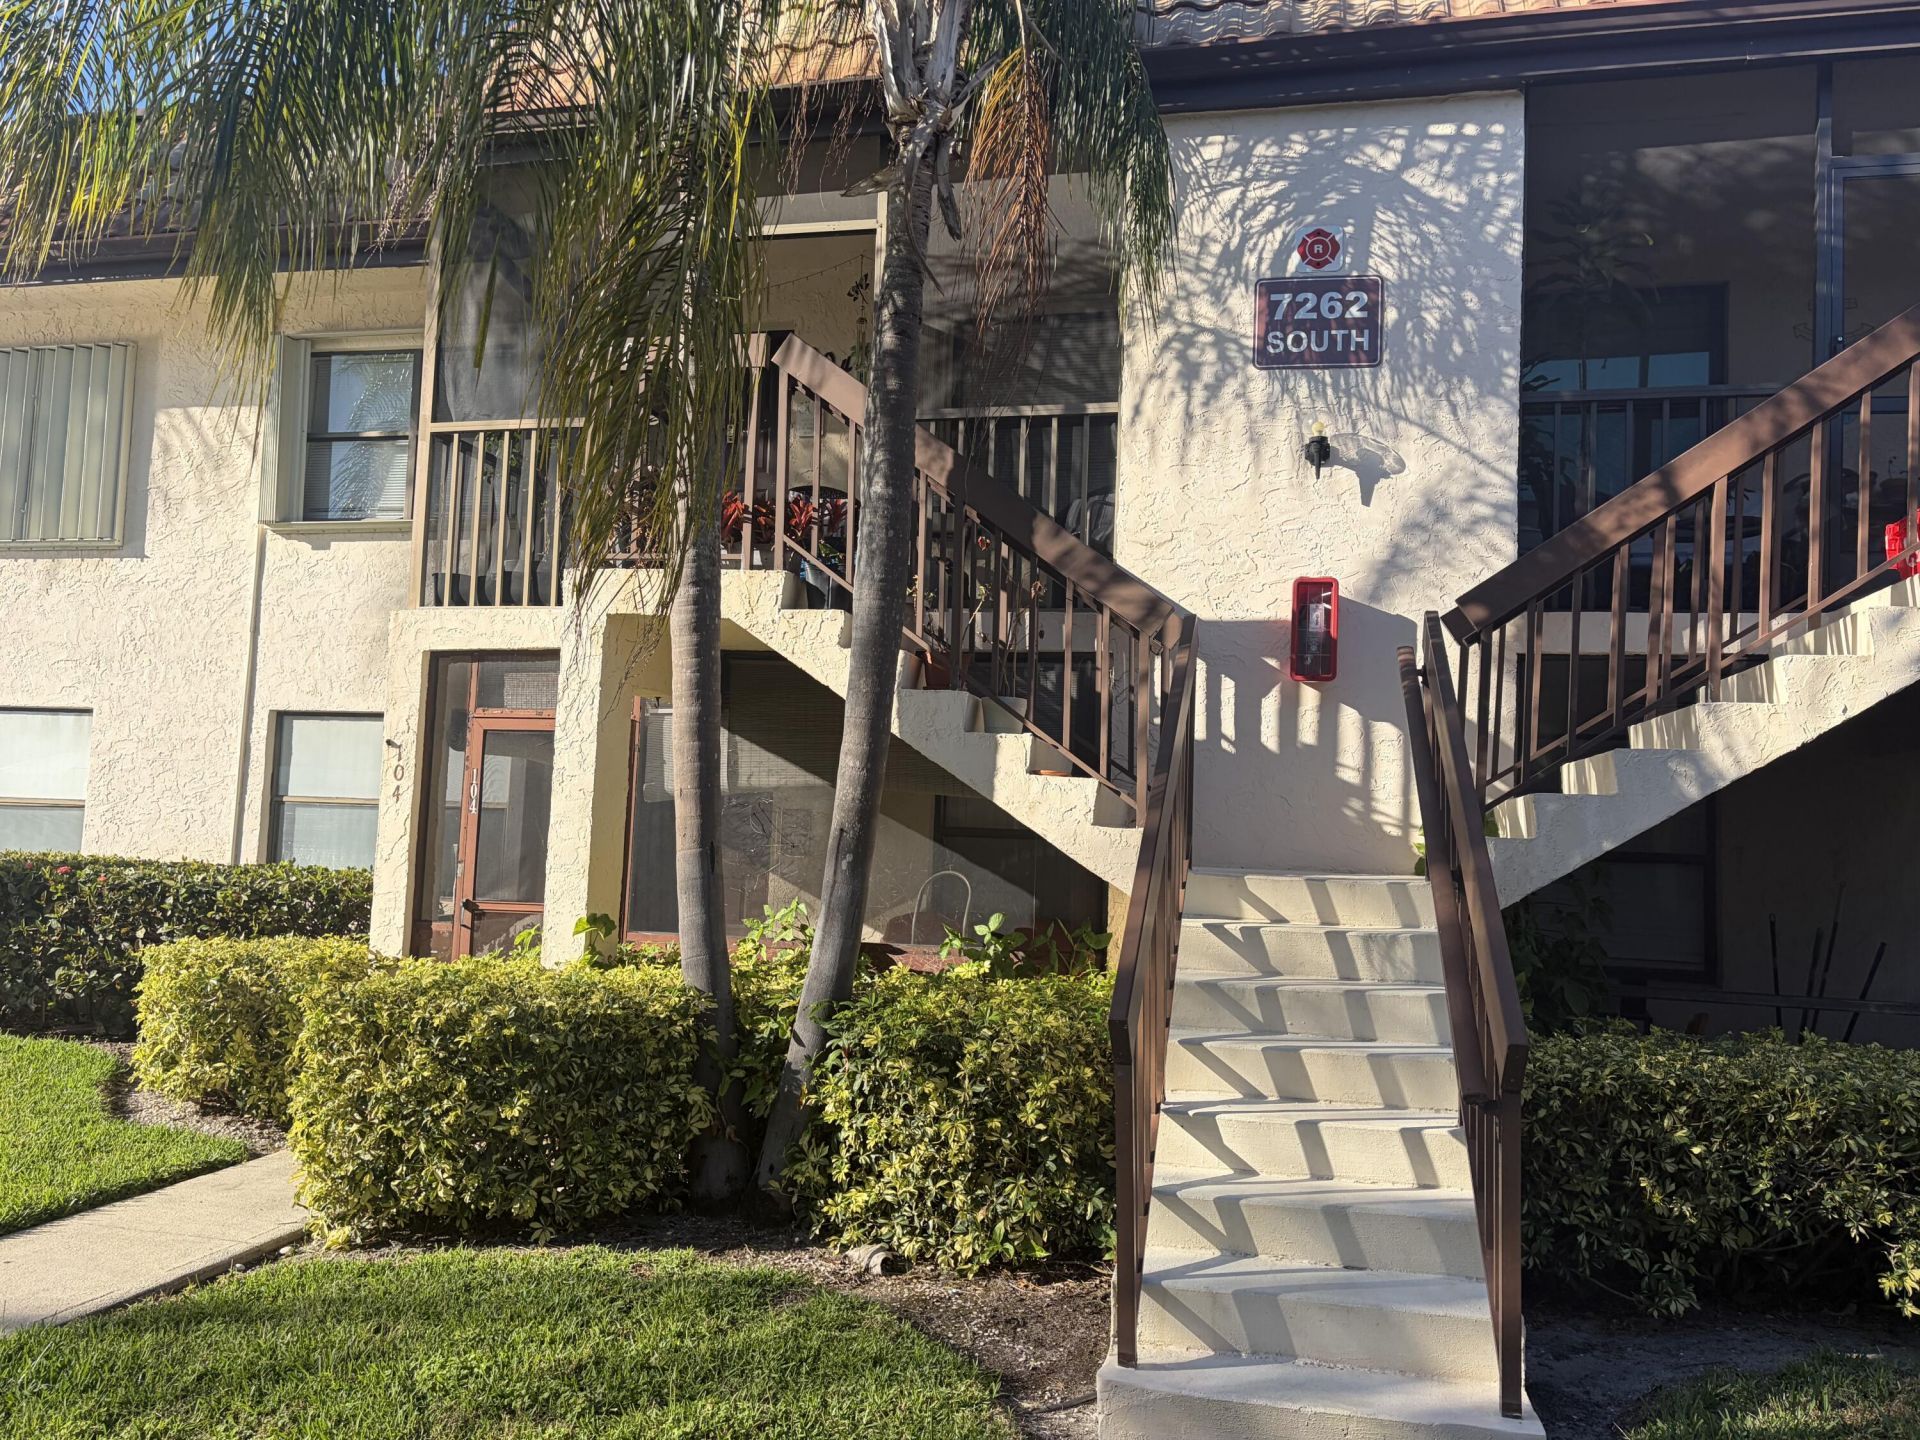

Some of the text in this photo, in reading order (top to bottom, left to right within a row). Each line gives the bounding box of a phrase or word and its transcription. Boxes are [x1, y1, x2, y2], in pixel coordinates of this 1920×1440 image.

[1313, 244, 1323, 254] R
[1270, 291, 1368, 320] 7262
[1266, 329, 1369, 353] SOUTH
[392, 744, 404, 804] 104
[468, 768, 479, 815] 104
